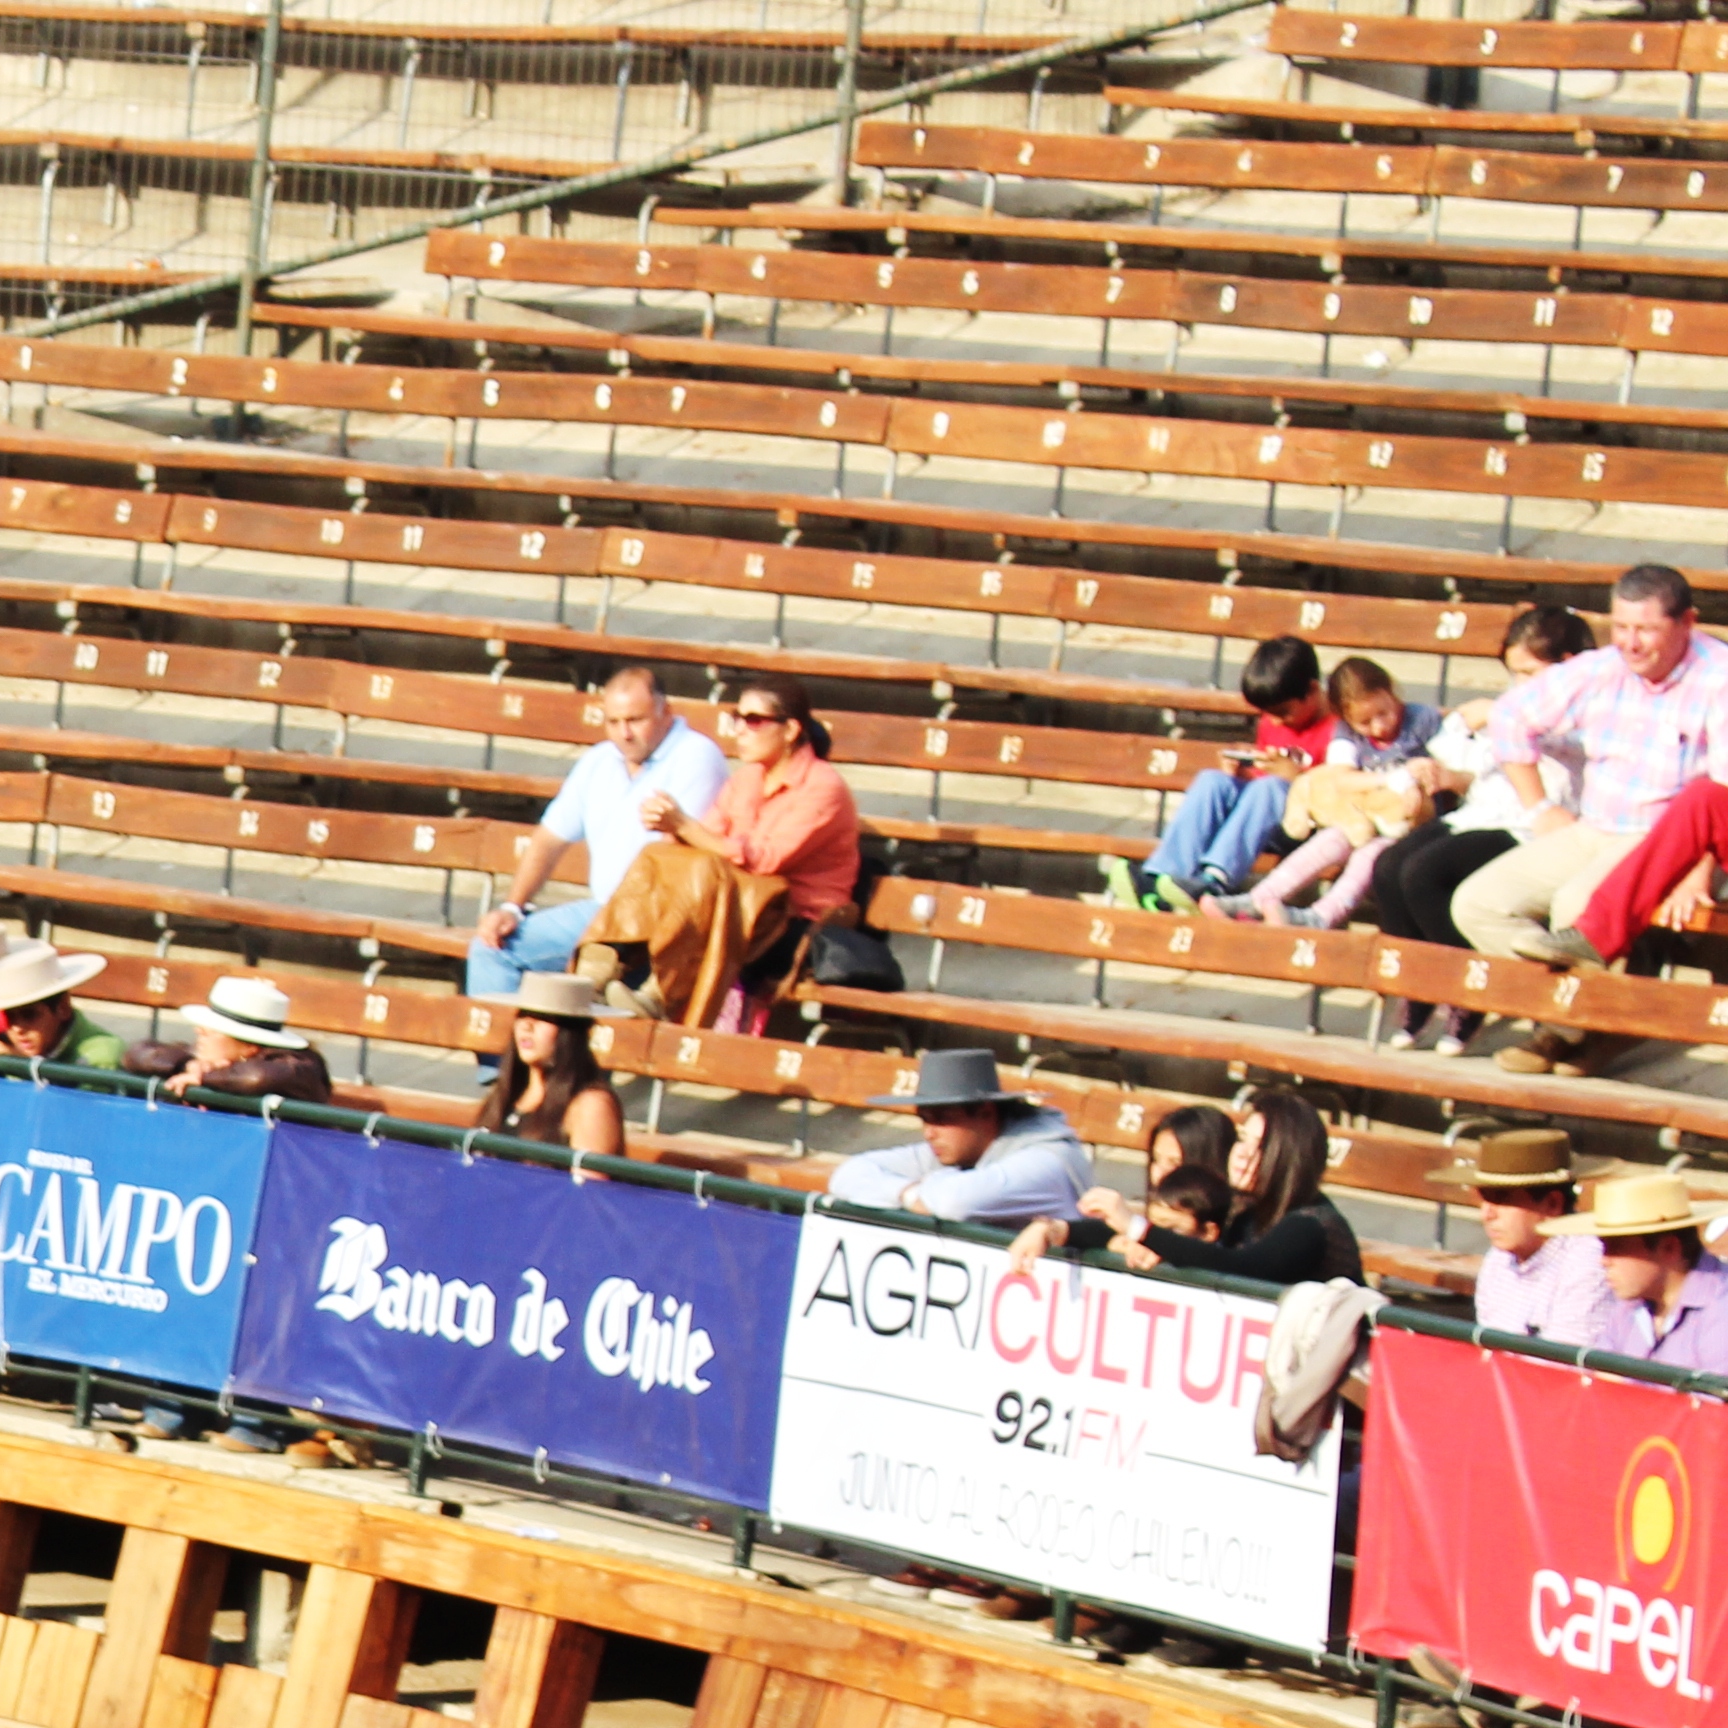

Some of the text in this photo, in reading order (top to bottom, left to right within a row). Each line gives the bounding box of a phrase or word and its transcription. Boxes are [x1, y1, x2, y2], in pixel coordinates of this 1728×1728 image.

[1340, 23, 1358, 47] 2
[1480, 29, 1497, 55] 3
[1145, 145, 1161, 168] 3
[1608, 165, 1624, 192] 7
[636, 250, 651, 275] 3
[877, 261, 896, 288] 5
[1106, 276, 1125, 302] 7
[1534, 296, 1557, 326] 11
[16, 346, 32, 370] 1
[483, 379, 500, 406] 5
[595, 383, 611, 409] 6
[1582, 452, 1607, 481] 15
[11, 485, 27, 508] 7
[320, 519, 344, 543] 10
[402, 525, 424, 551] 11
[520, 531, 546, 559] 12
[620, 538, 644, 565] 13
[852, 562, 876, 588] 15
[1435, 611, 1467, 639] 20
[74, 643, 98, 669] 10
[146, 650, 169, 676] 11
[370, 675, 394, 699] 13
[1148, 749, 1178, 774] 20
[92, 791, 115, 819] 13
[957, 896, 986, 926] 21
[1089, 919, 1111, 946] 22
[677, 1036, 701, 1064] 21
[1116, 1102, 1145, 1133] 25
[27, 1267, 169, 1313] EL MERCURIO
[315, 1216, 715, 1395] Banco de Chile
[839, 1450, 1273, 1604] JUNTO AL RODEO CHILENO!!!
